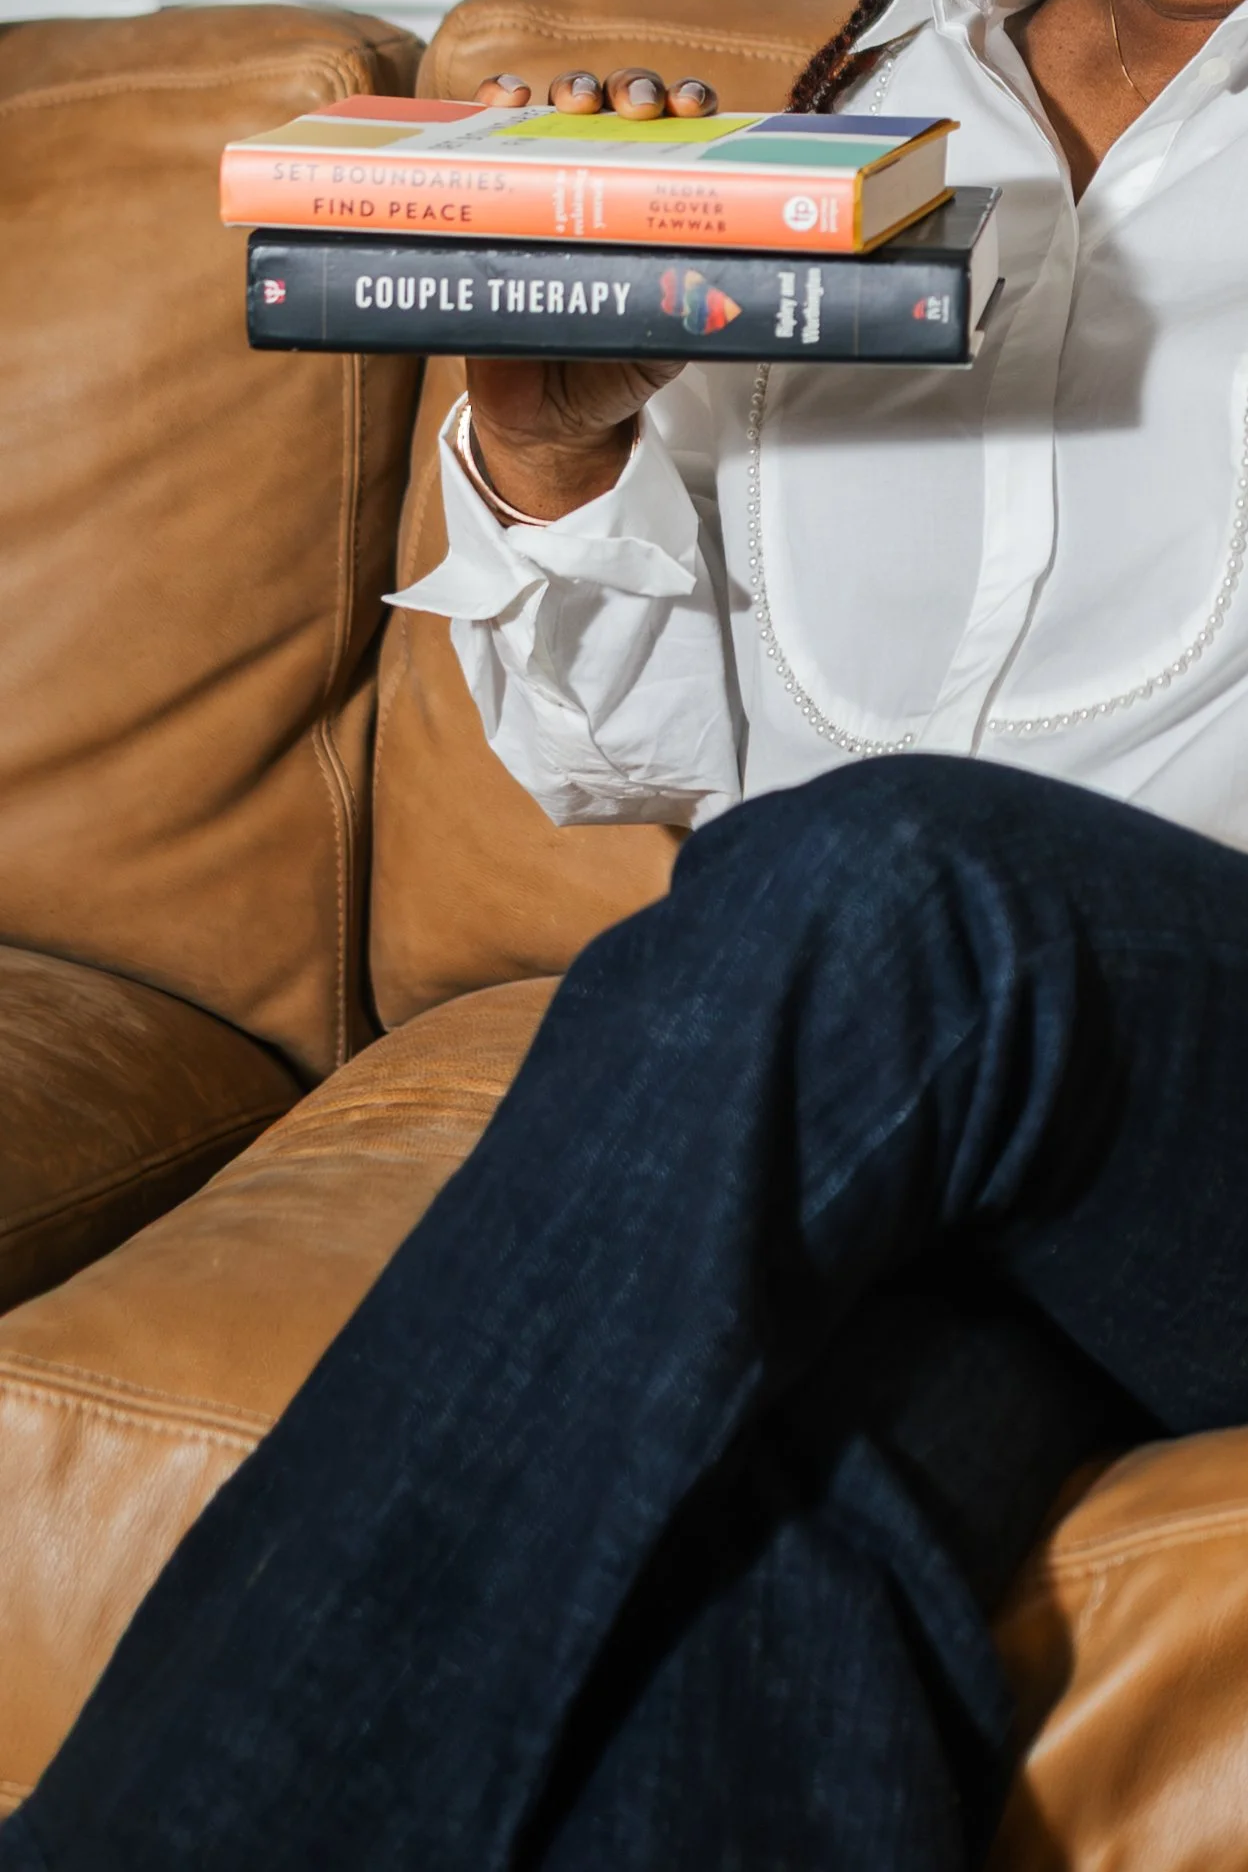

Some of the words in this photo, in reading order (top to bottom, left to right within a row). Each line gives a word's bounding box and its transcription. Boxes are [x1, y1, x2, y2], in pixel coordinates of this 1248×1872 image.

[273, 162, 319, 182] SET
[313, 198, 375, 217] FIND
[389, 201, 473, 222] PEACE
[649, 200, 724, 214] GLOVER
[647, 217, 727, 232] TAWWAB
[355, 276, 475, 312] COUPLE
[487, 279, 632, 315] THERAPY
